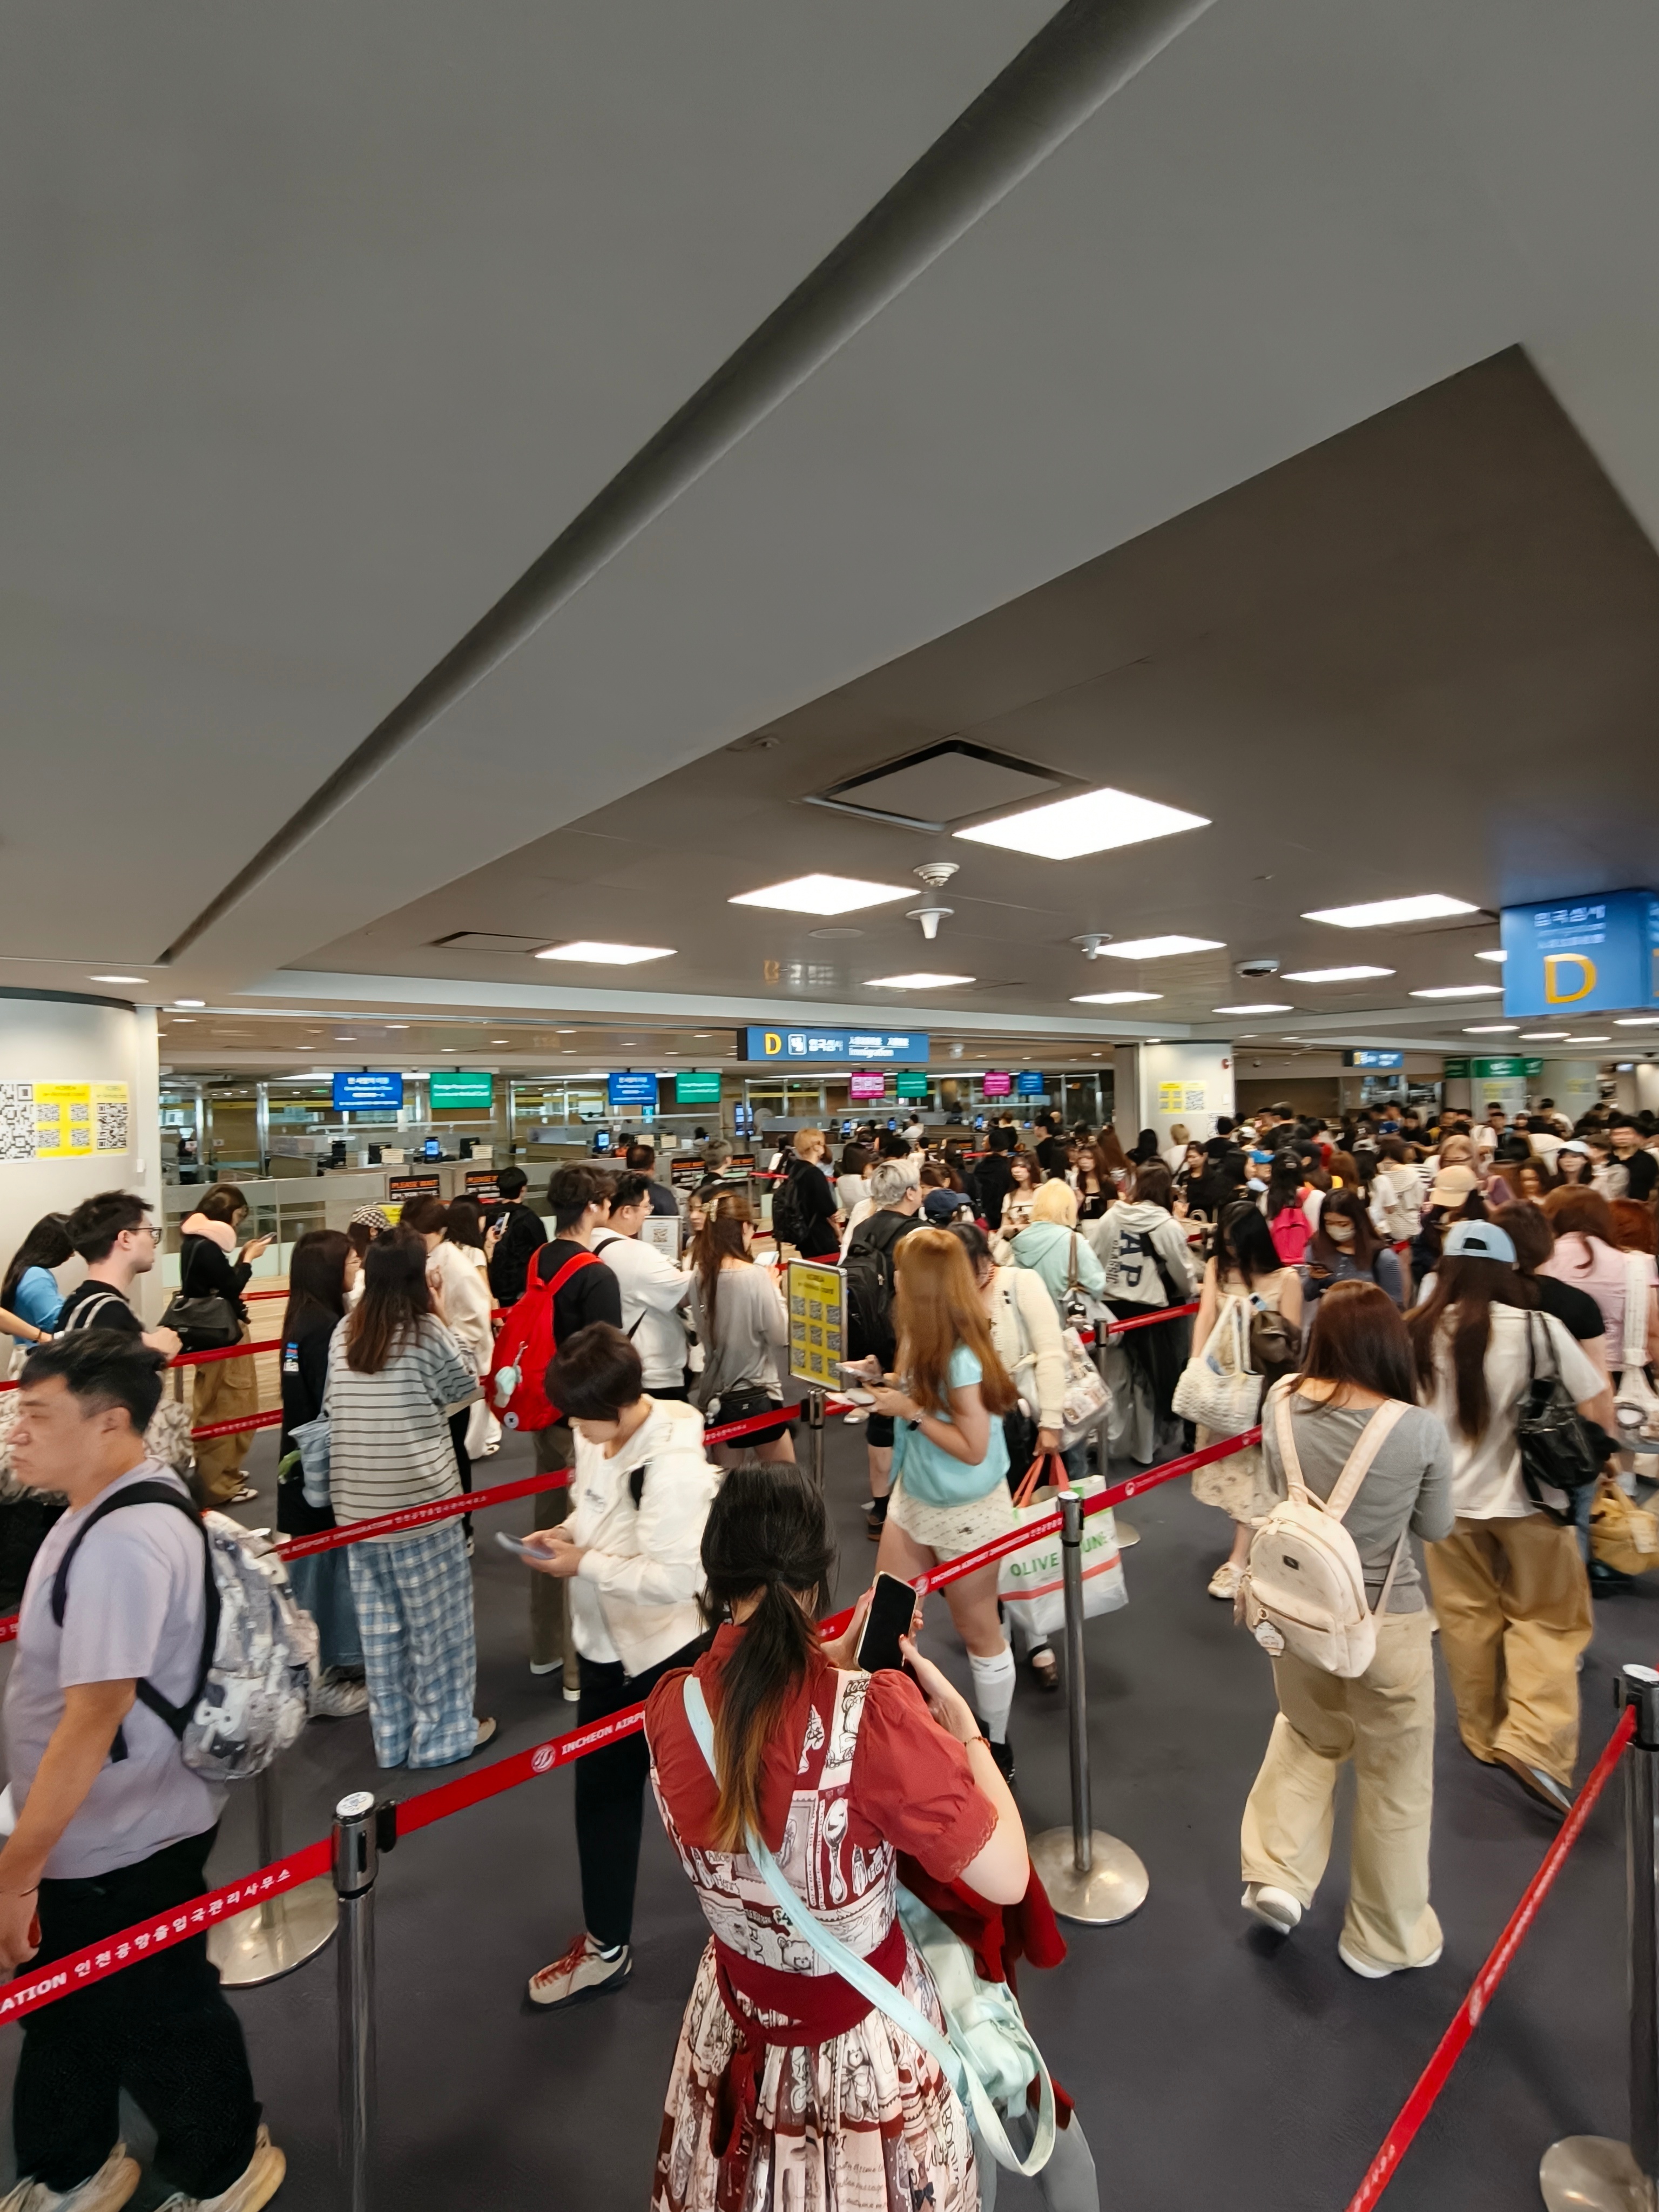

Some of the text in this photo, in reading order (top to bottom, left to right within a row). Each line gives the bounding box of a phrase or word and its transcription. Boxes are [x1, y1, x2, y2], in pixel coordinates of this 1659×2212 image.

[1543, 953, 1597, 1004] D
[765, 1032, 782, 1055] D
[1009, 1552, 1060, 1577] OLIVE
[562, 1725, 613, 1755] INCHEON
[74, 1869, 291, 1978] 인천공항출입국관리사무소
